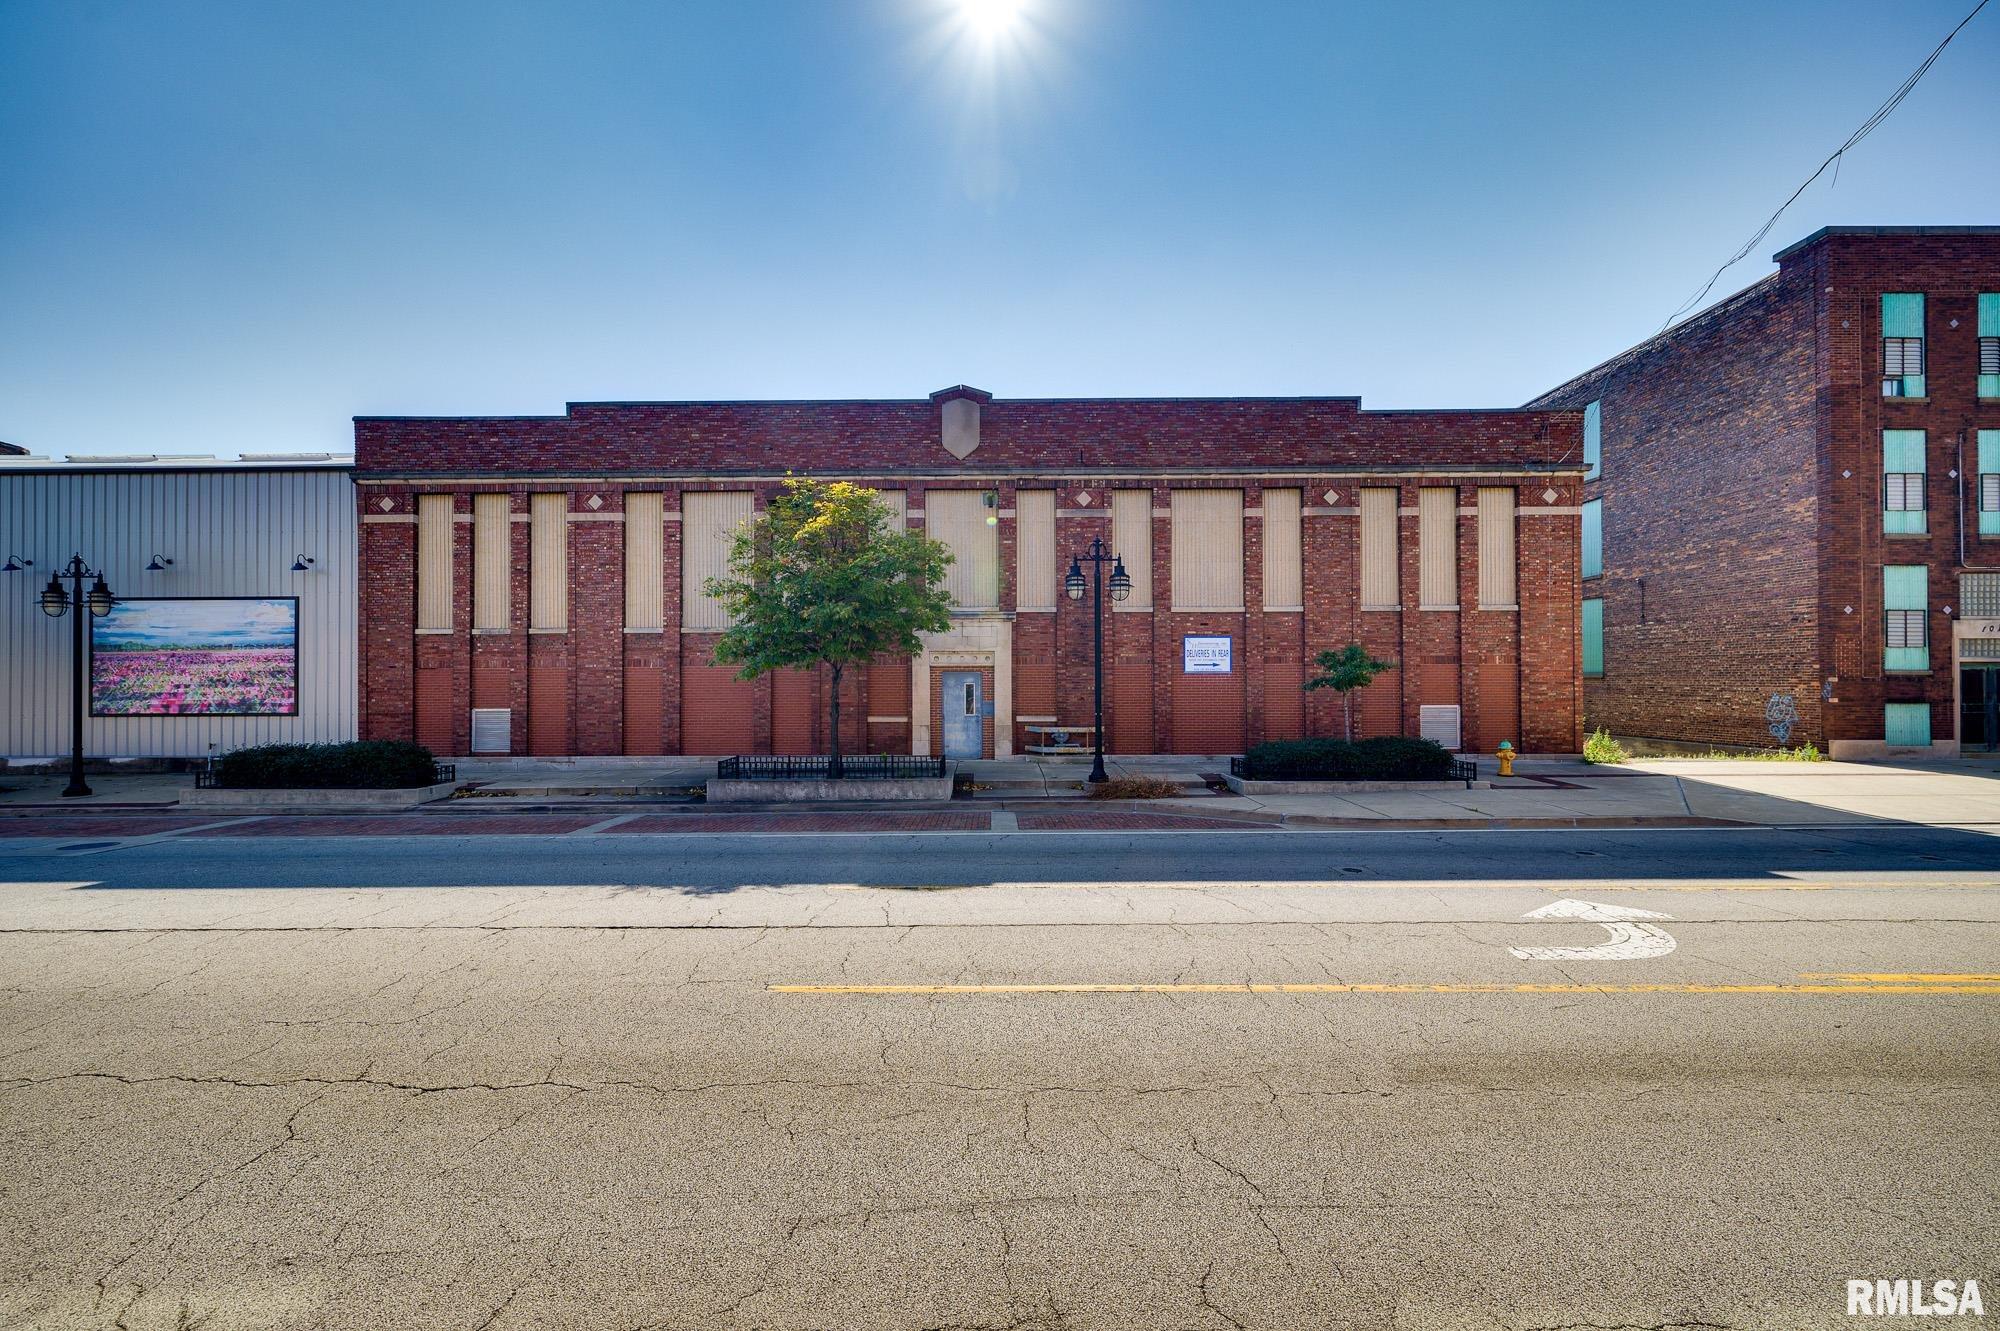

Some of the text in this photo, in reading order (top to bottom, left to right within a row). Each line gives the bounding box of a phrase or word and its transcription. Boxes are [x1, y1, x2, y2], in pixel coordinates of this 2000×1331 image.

[1187, 649, 1230, 658] DELIVERIES IN REAR
